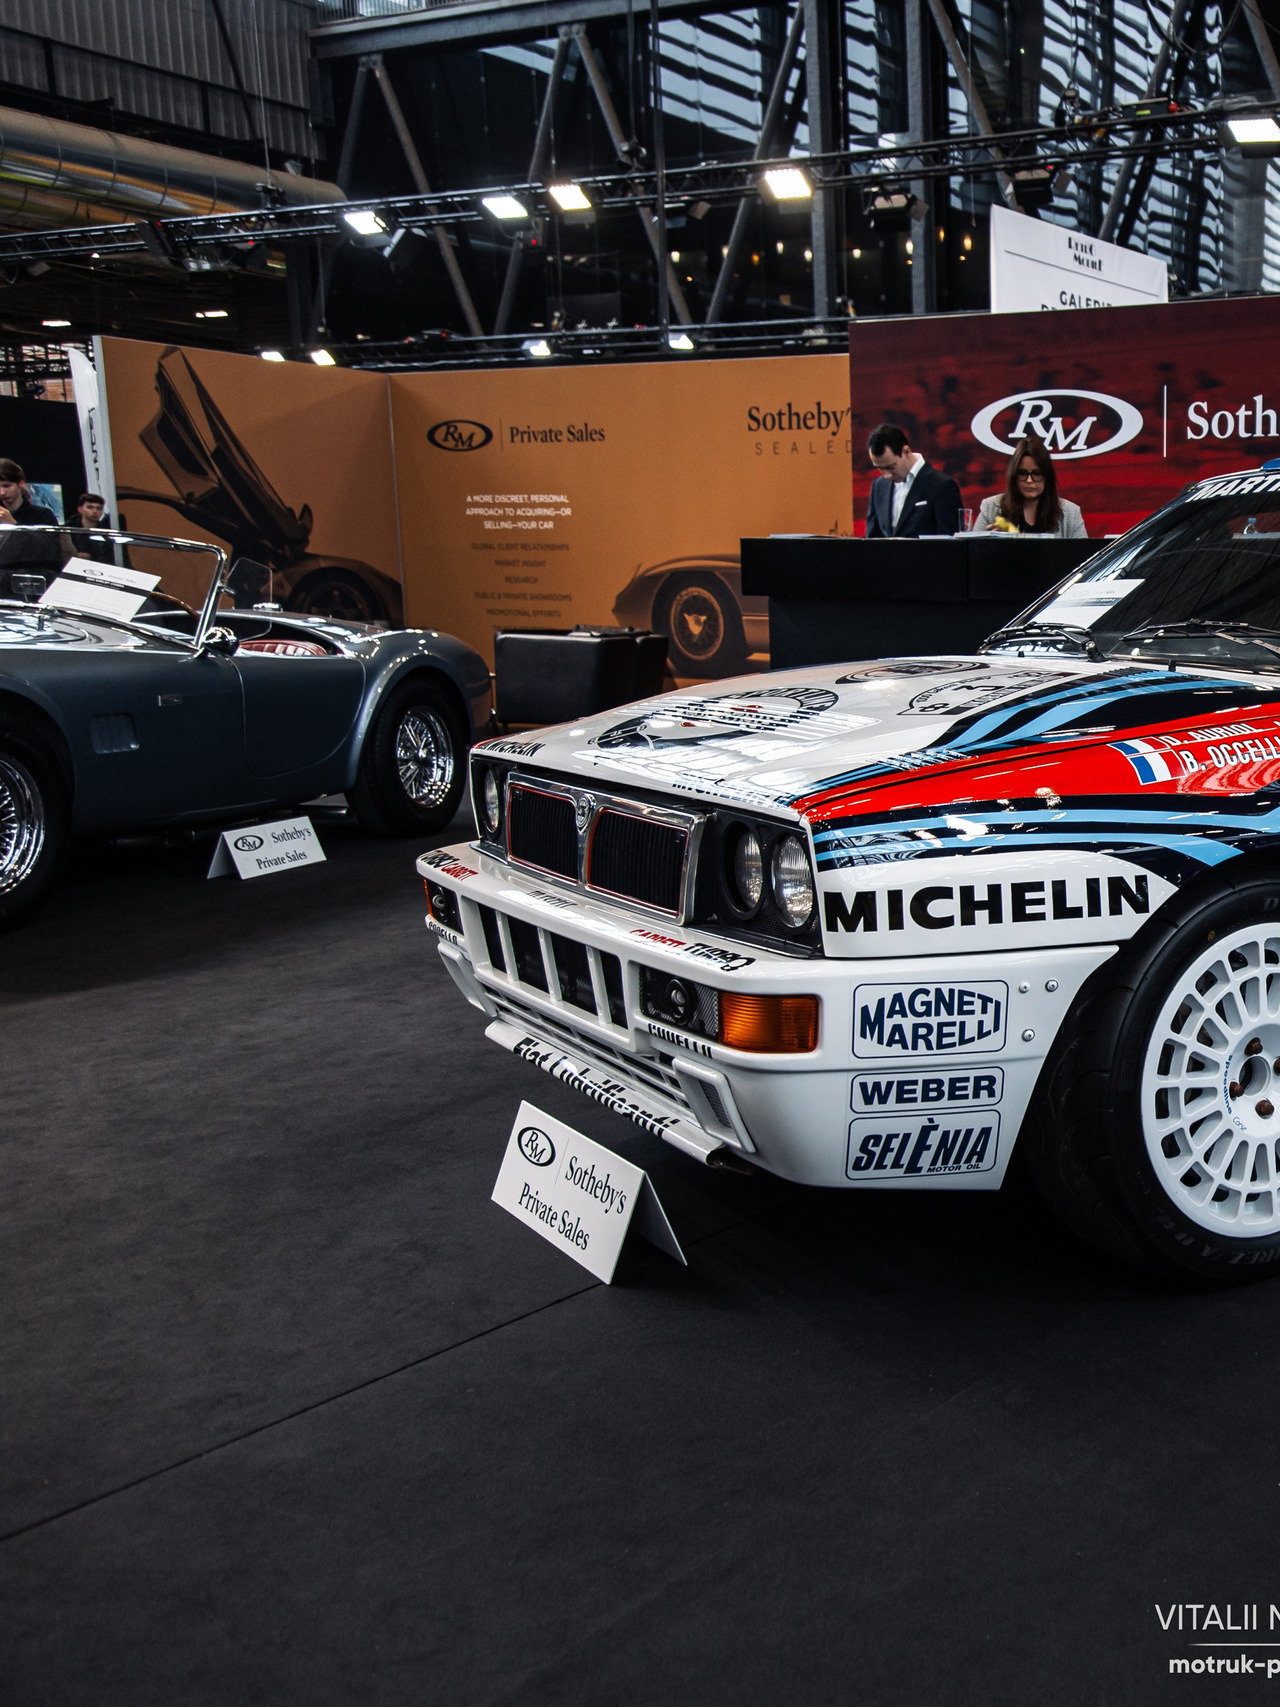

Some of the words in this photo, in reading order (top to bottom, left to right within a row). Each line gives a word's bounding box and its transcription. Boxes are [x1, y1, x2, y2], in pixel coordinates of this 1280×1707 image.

[509, 425, 563, 443] Private
[567, 422, 606, 442] Sales
[1008, 400, 1098, 451] RM
[473, 495, 494, 503] MORE
[530, 495, 569, 503] PERSONAL
[466, 508, 504, 516] APPROACH
[505, 508, 515, 516] TO
[538, 521, 554, 529] CAR
[504, 576, 539, 584] RESEARCH
[1181, 750, 1207, 773] B.
[271, 827, 312, 844] Sotheby's
[256, 857, 286, 870] Private
[285, 850, 308, 863] Sales
[823, 874, 1150, 933] MICHELIN
[860, 987, 1001, 1034] MAGNETI
[859, 1075, 997, 1106] WEBER
[1223, 1054, 1234, 1116] speedline
[1232, 1116, 1248, 1132] Corse
[927, 1165, 962, 1174] MOTOR
[966, 1163, 981, 1171] OIL
[565, 1155, 627, 1215] Sotheby's
[518, 1182, 558, 1228] Private
[558, 1210, 590, 1251] Sales
